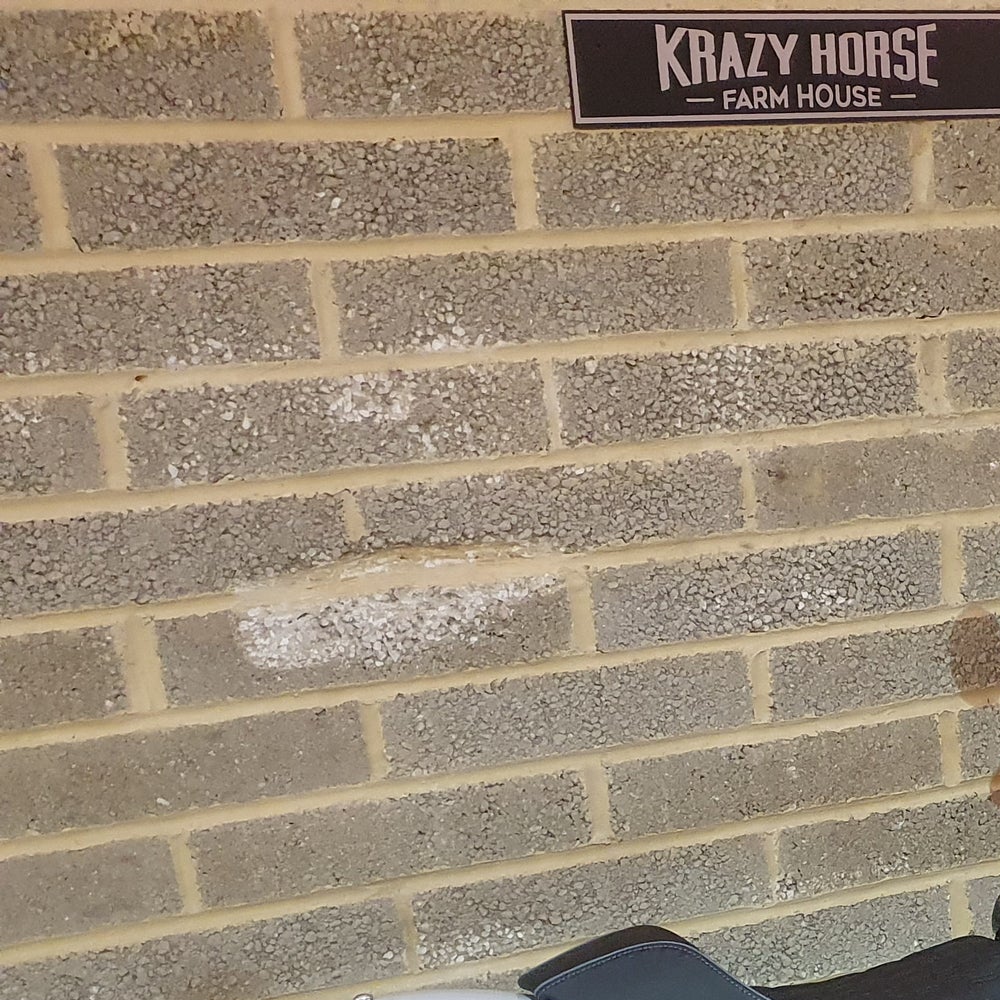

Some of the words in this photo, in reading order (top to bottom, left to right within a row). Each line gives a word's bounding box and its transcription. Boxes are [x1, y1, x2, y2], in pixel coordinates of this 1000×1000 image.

[654, 23, 799, 92] KRAZY
[810, 23, 939, 88] HORSE
[723, 84, 789, 111] FARM
[799, 83, 882, 109] HOUSE
